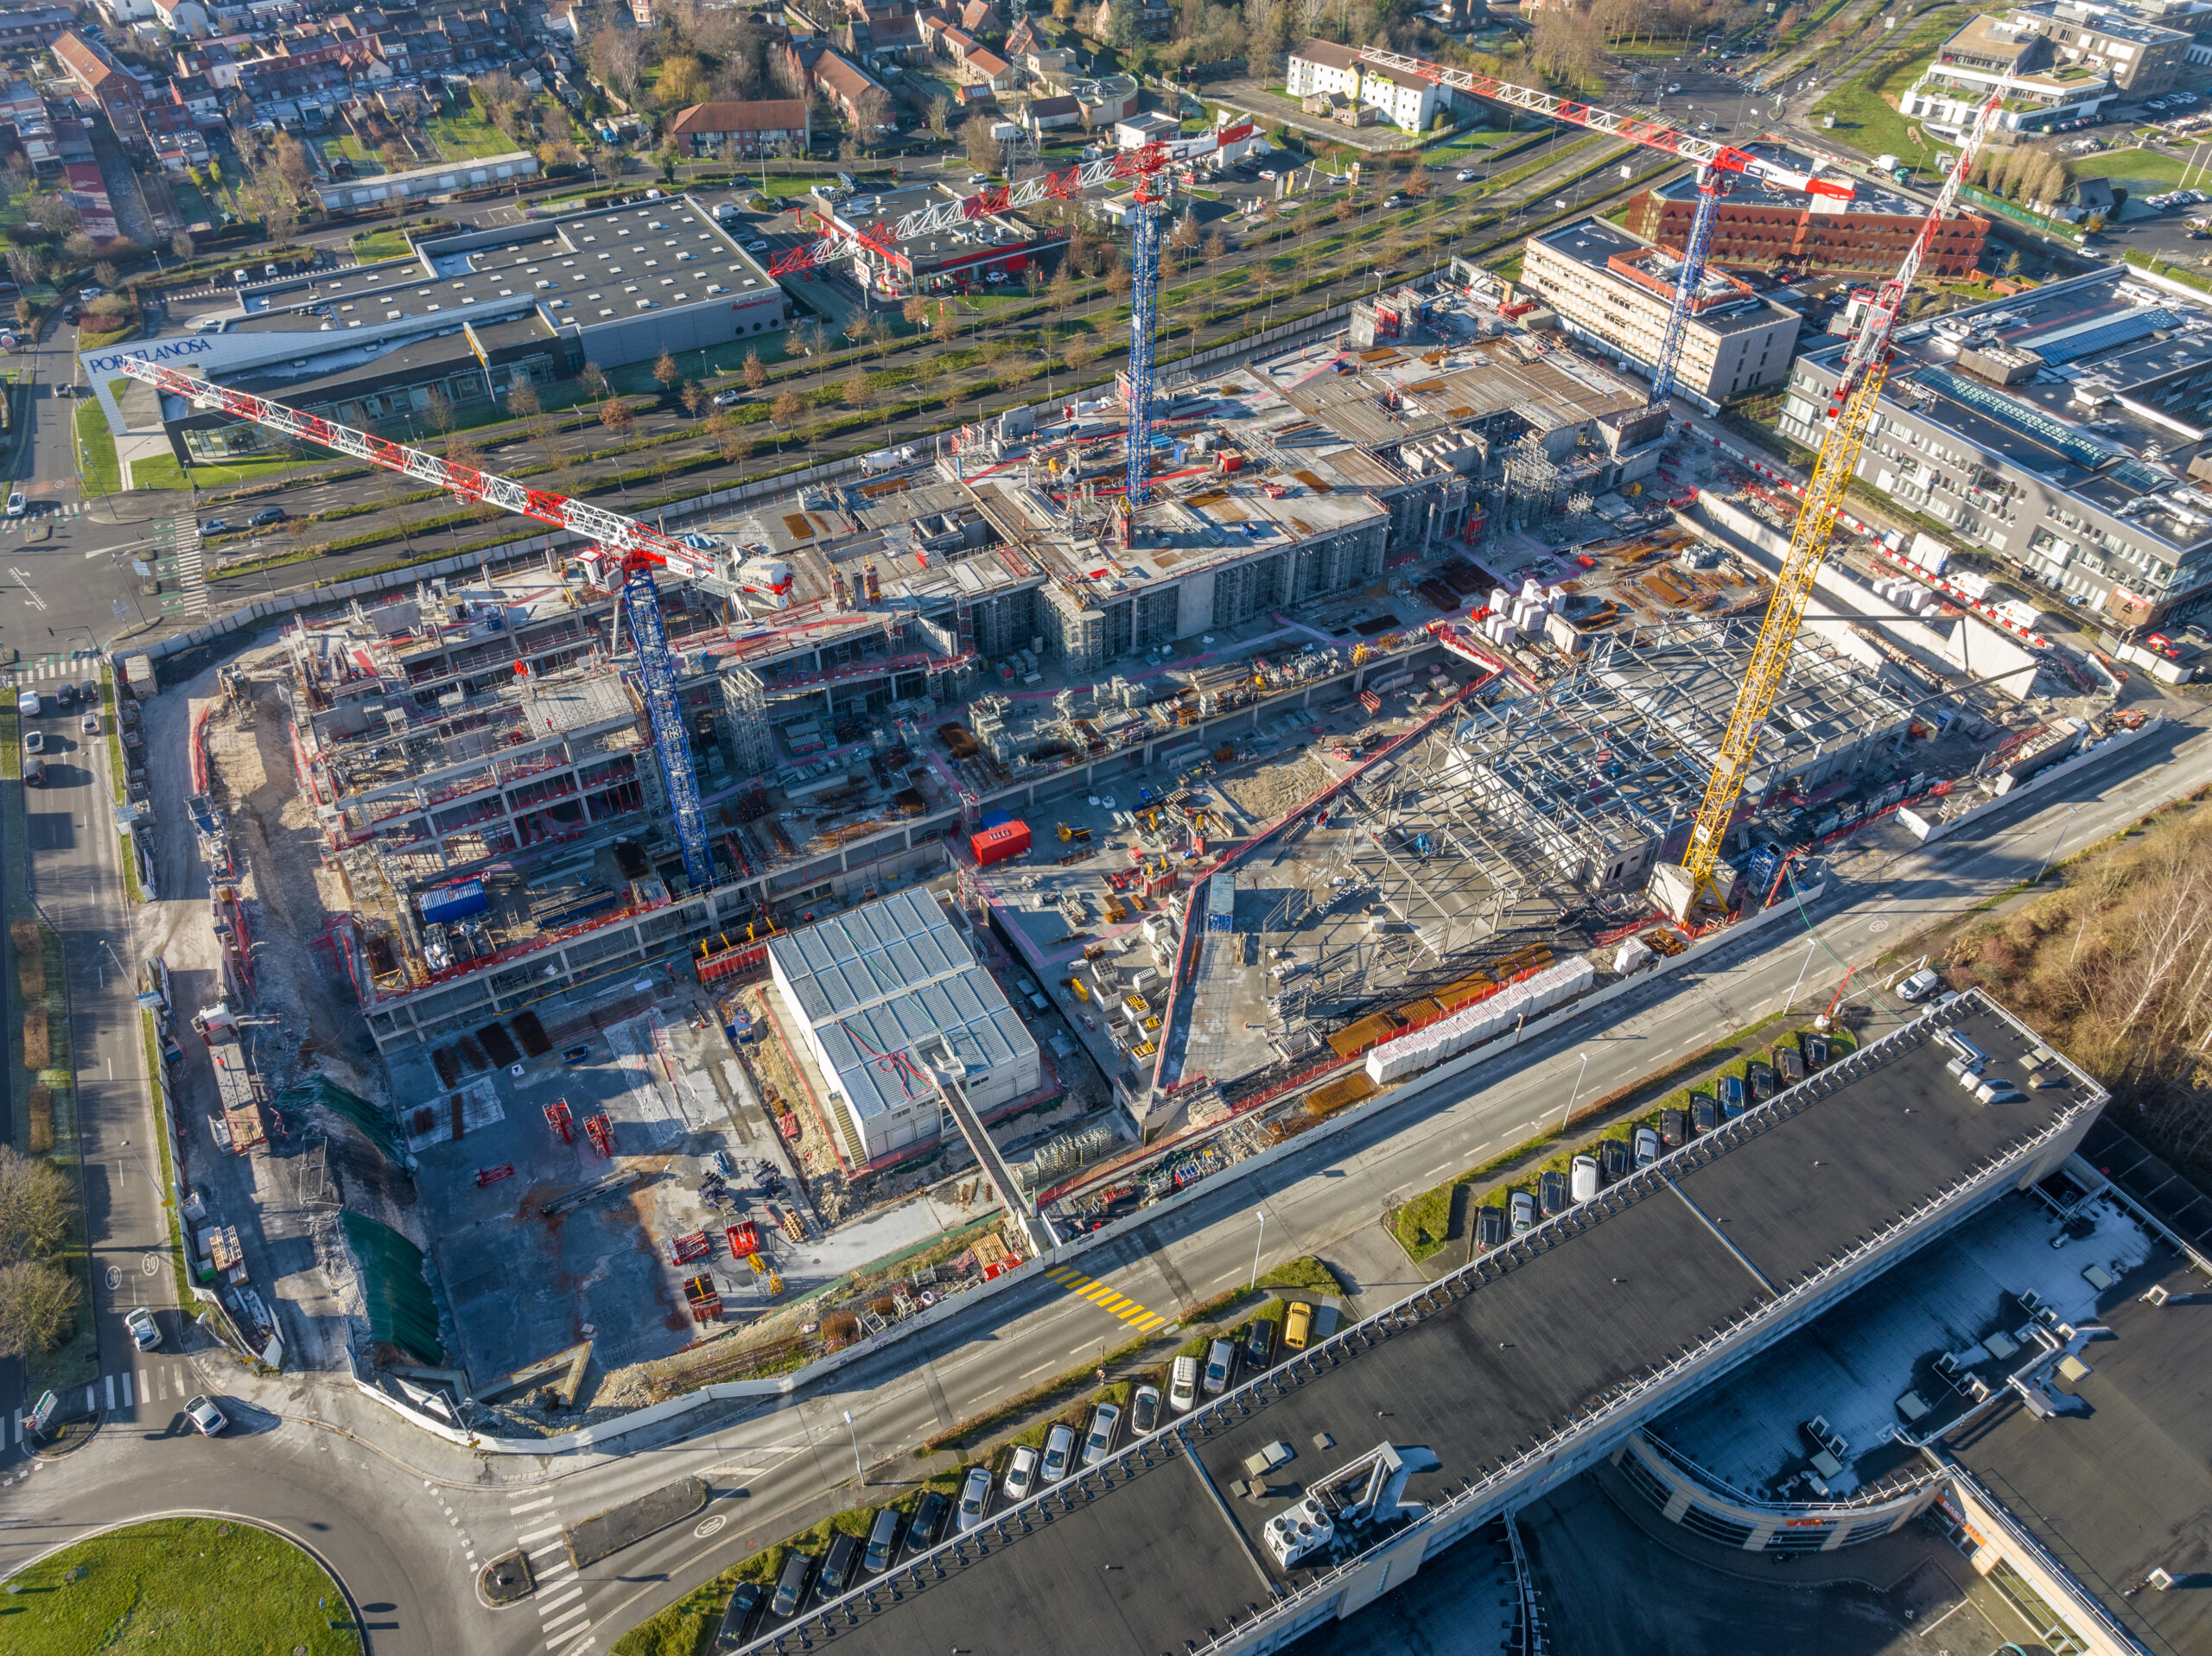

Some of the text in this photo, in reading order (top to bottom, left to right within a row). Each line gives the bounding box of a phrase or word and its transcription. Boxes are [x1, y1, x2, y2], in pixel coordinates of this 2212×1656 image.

[667, 727, 681, 739] G3
[146, 1256, 156, 1272] 30
[109, 1270, 118, 1285] 30
[700, 1518, 721, 1534] 30
